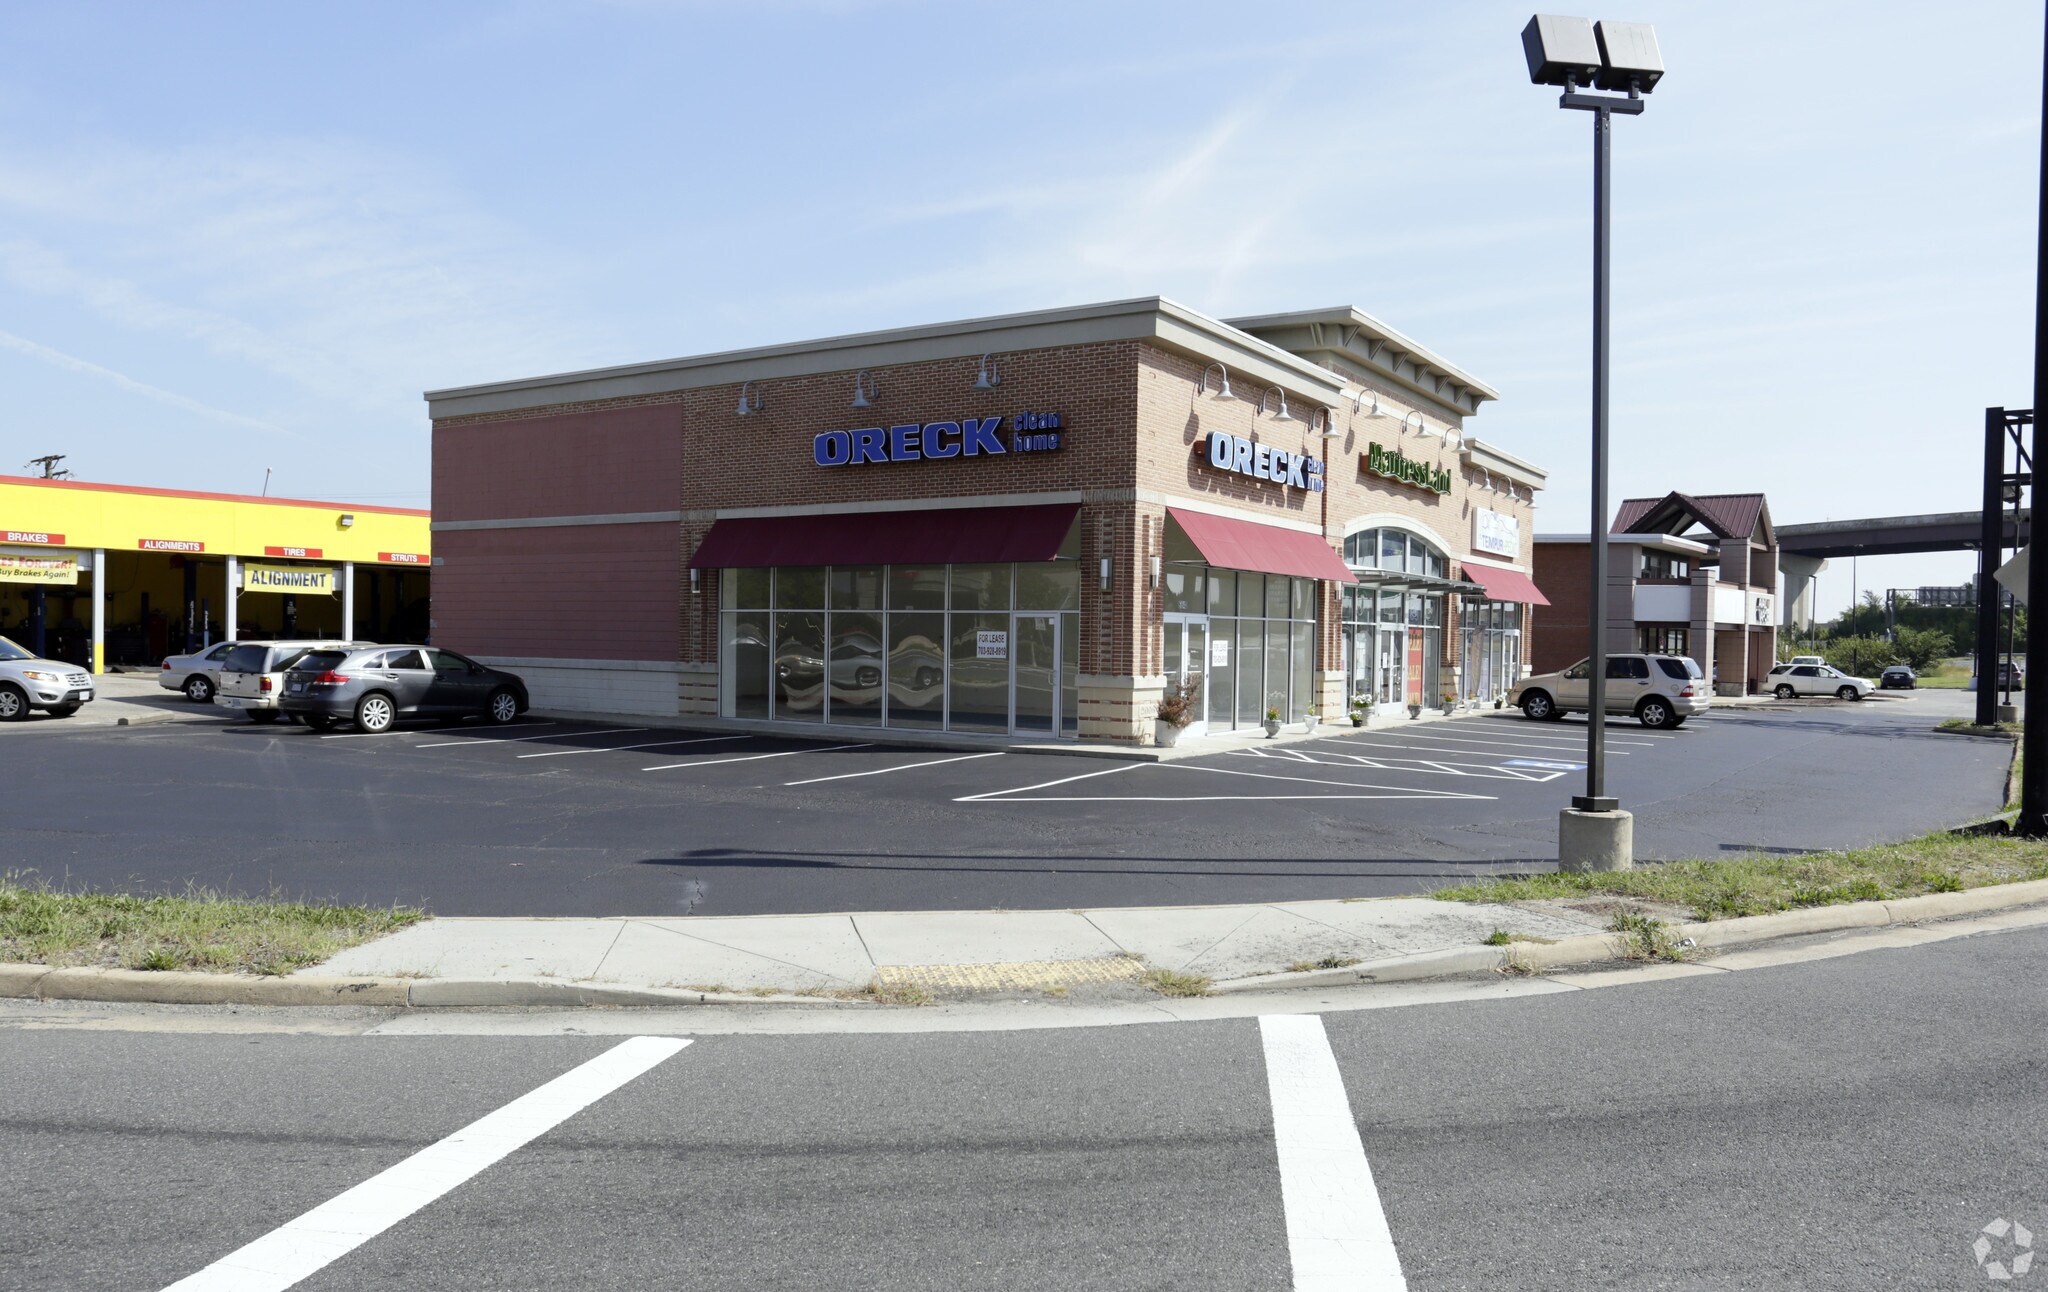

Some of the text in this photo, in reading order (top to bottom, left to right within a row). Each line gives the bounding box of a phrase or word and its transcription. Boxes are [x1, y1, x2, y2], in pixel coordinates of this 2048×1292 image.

[1013, 410, 1061, 431] clean
[814, 417, 1007, 466] ORECK
[1013, 432, 1059, 453] home
[1209, 431, 1305, 489] ORECK
[7, 532, 49, 543] BRAKES
[143, 540, 201, 551] ALIGNMENTS
[283, 547, 306, 557] TIRES
[391, 553, 418, 563] STRUTS
[14, 568, 42, 577] Brakes
[43, 570, 70, 580] Again!
[251, 570, 326, 588] ALIGNMENT
[978, 634, 1005, 643] FOR LEASE
